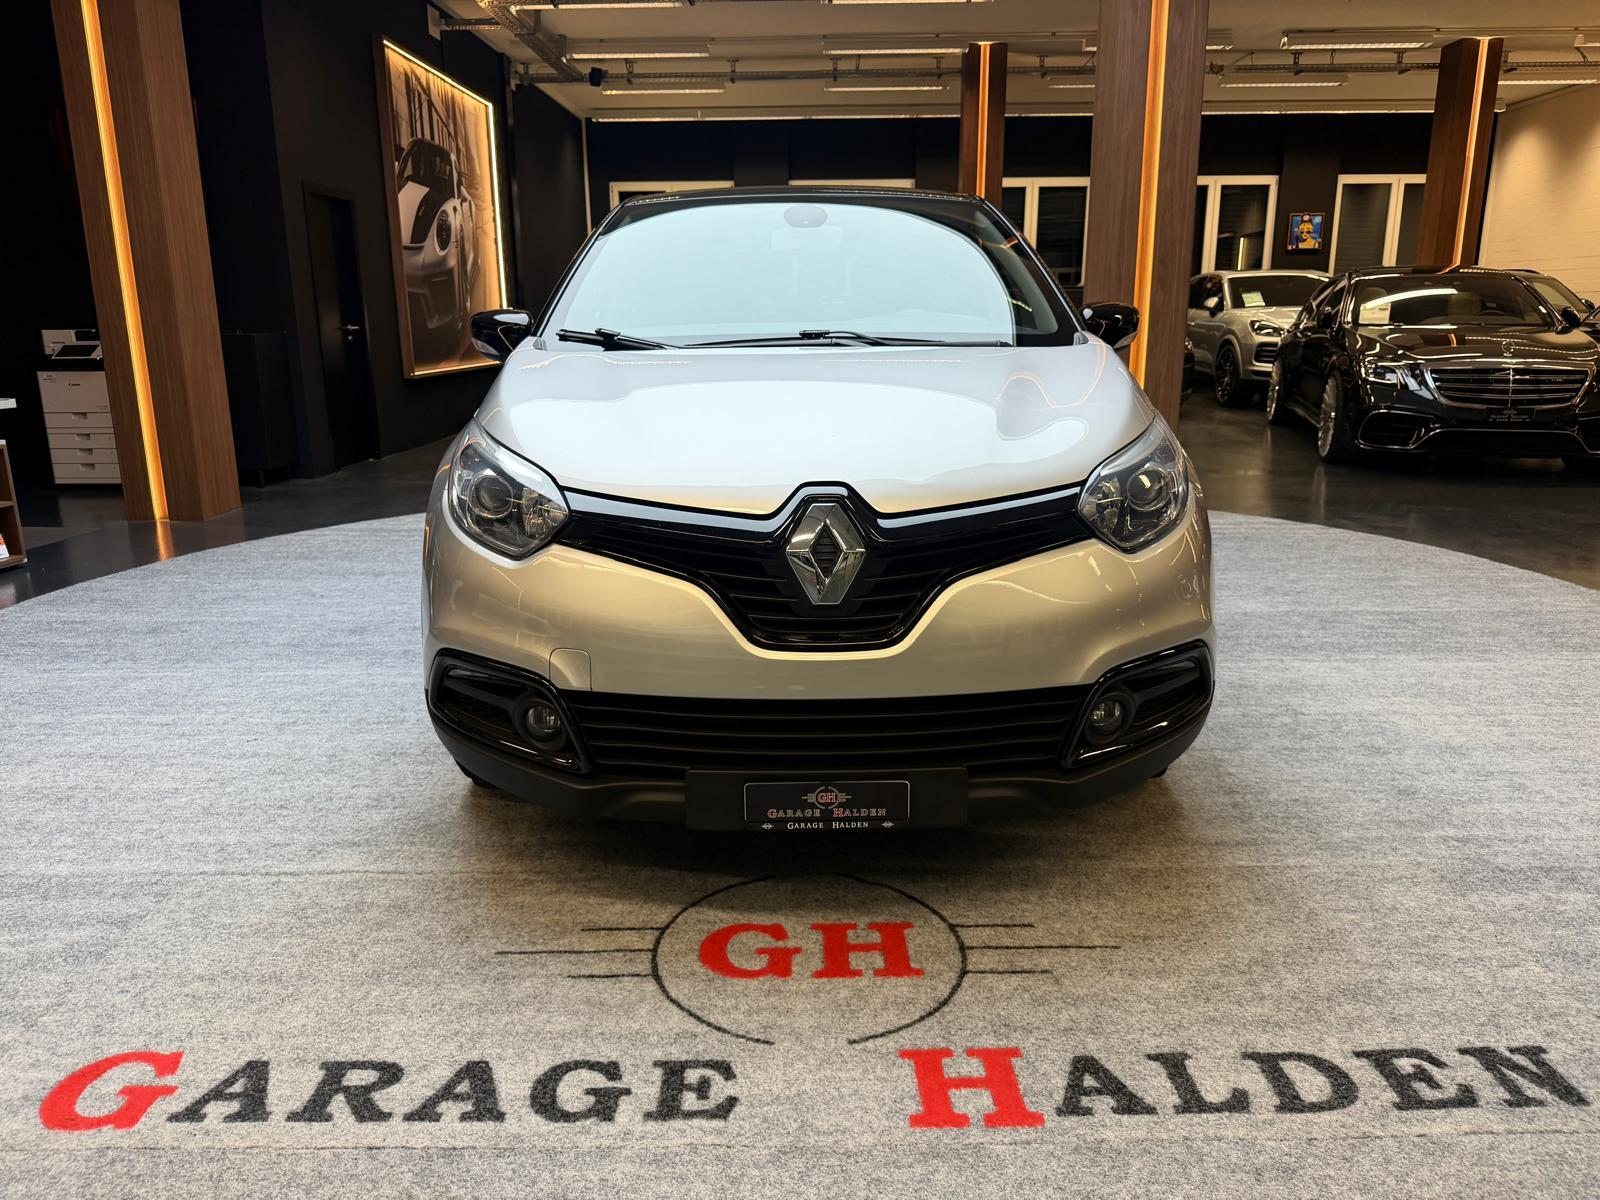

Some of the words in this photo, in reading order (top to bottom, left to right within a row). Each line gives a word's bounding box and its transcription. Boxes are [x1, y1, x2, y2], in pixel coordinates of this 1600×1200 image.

[817, 793, 838, 803] GH
[767, 808, 821, 819] GARAGE
[832, 807, 887, 818] HALDEN
[787, 821, 824, 830] GARAGE
[832, 821, 869, 829] HALDEN
[698, 921, 925, 979] GH
[38, 1050, 742, 1131] GARAGE
[899, 1045, 1594, 1129] HALDEN
